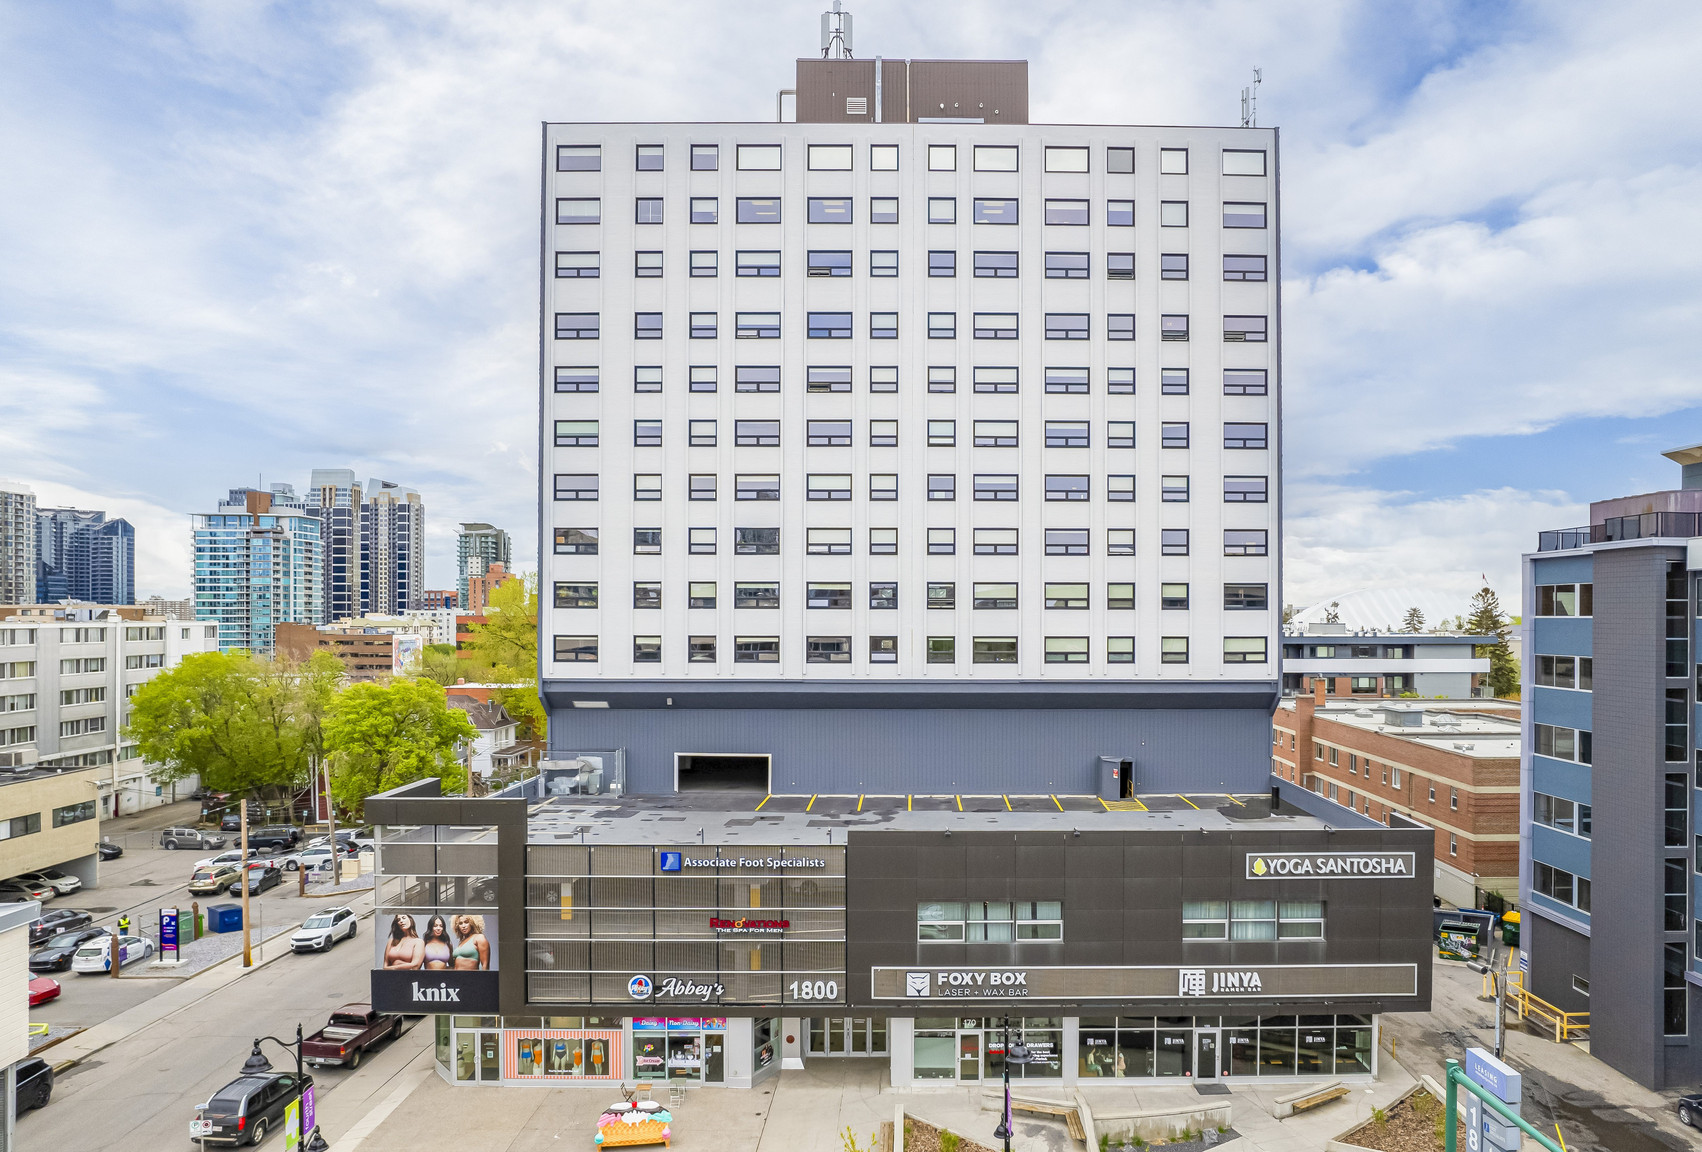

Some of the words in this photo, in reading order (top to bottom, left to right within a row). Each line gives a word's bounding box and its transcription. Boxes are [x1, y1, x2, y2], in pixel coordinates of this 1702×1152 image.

[684, 857, 737, 868] Associate
[739, 857, 764, 868] Foot
[766, 857, 825, 870] Specialists
[1267, 857, 1314, 875] YOGA
[1316, 857, 1407, 875] SANTOSHA
[937, 972, 986, 986] FOXY
[990, 972, 1027, 986] BOX
[1212, 972, 1262, 993] JINYA
[411, 981, 461, 1002] knix
[654, 977, 725, 1002] Abbey's
[789, 980, 838, 1000] 1800
[938, 988, 971, 997] LASER
[983, 988, 1005, 997] WAX
[1008, 988, 1029, 997] BAR
[963, 1019, 977, 1027] 170
[1474, 1062, 1498, 1084] LEASING
